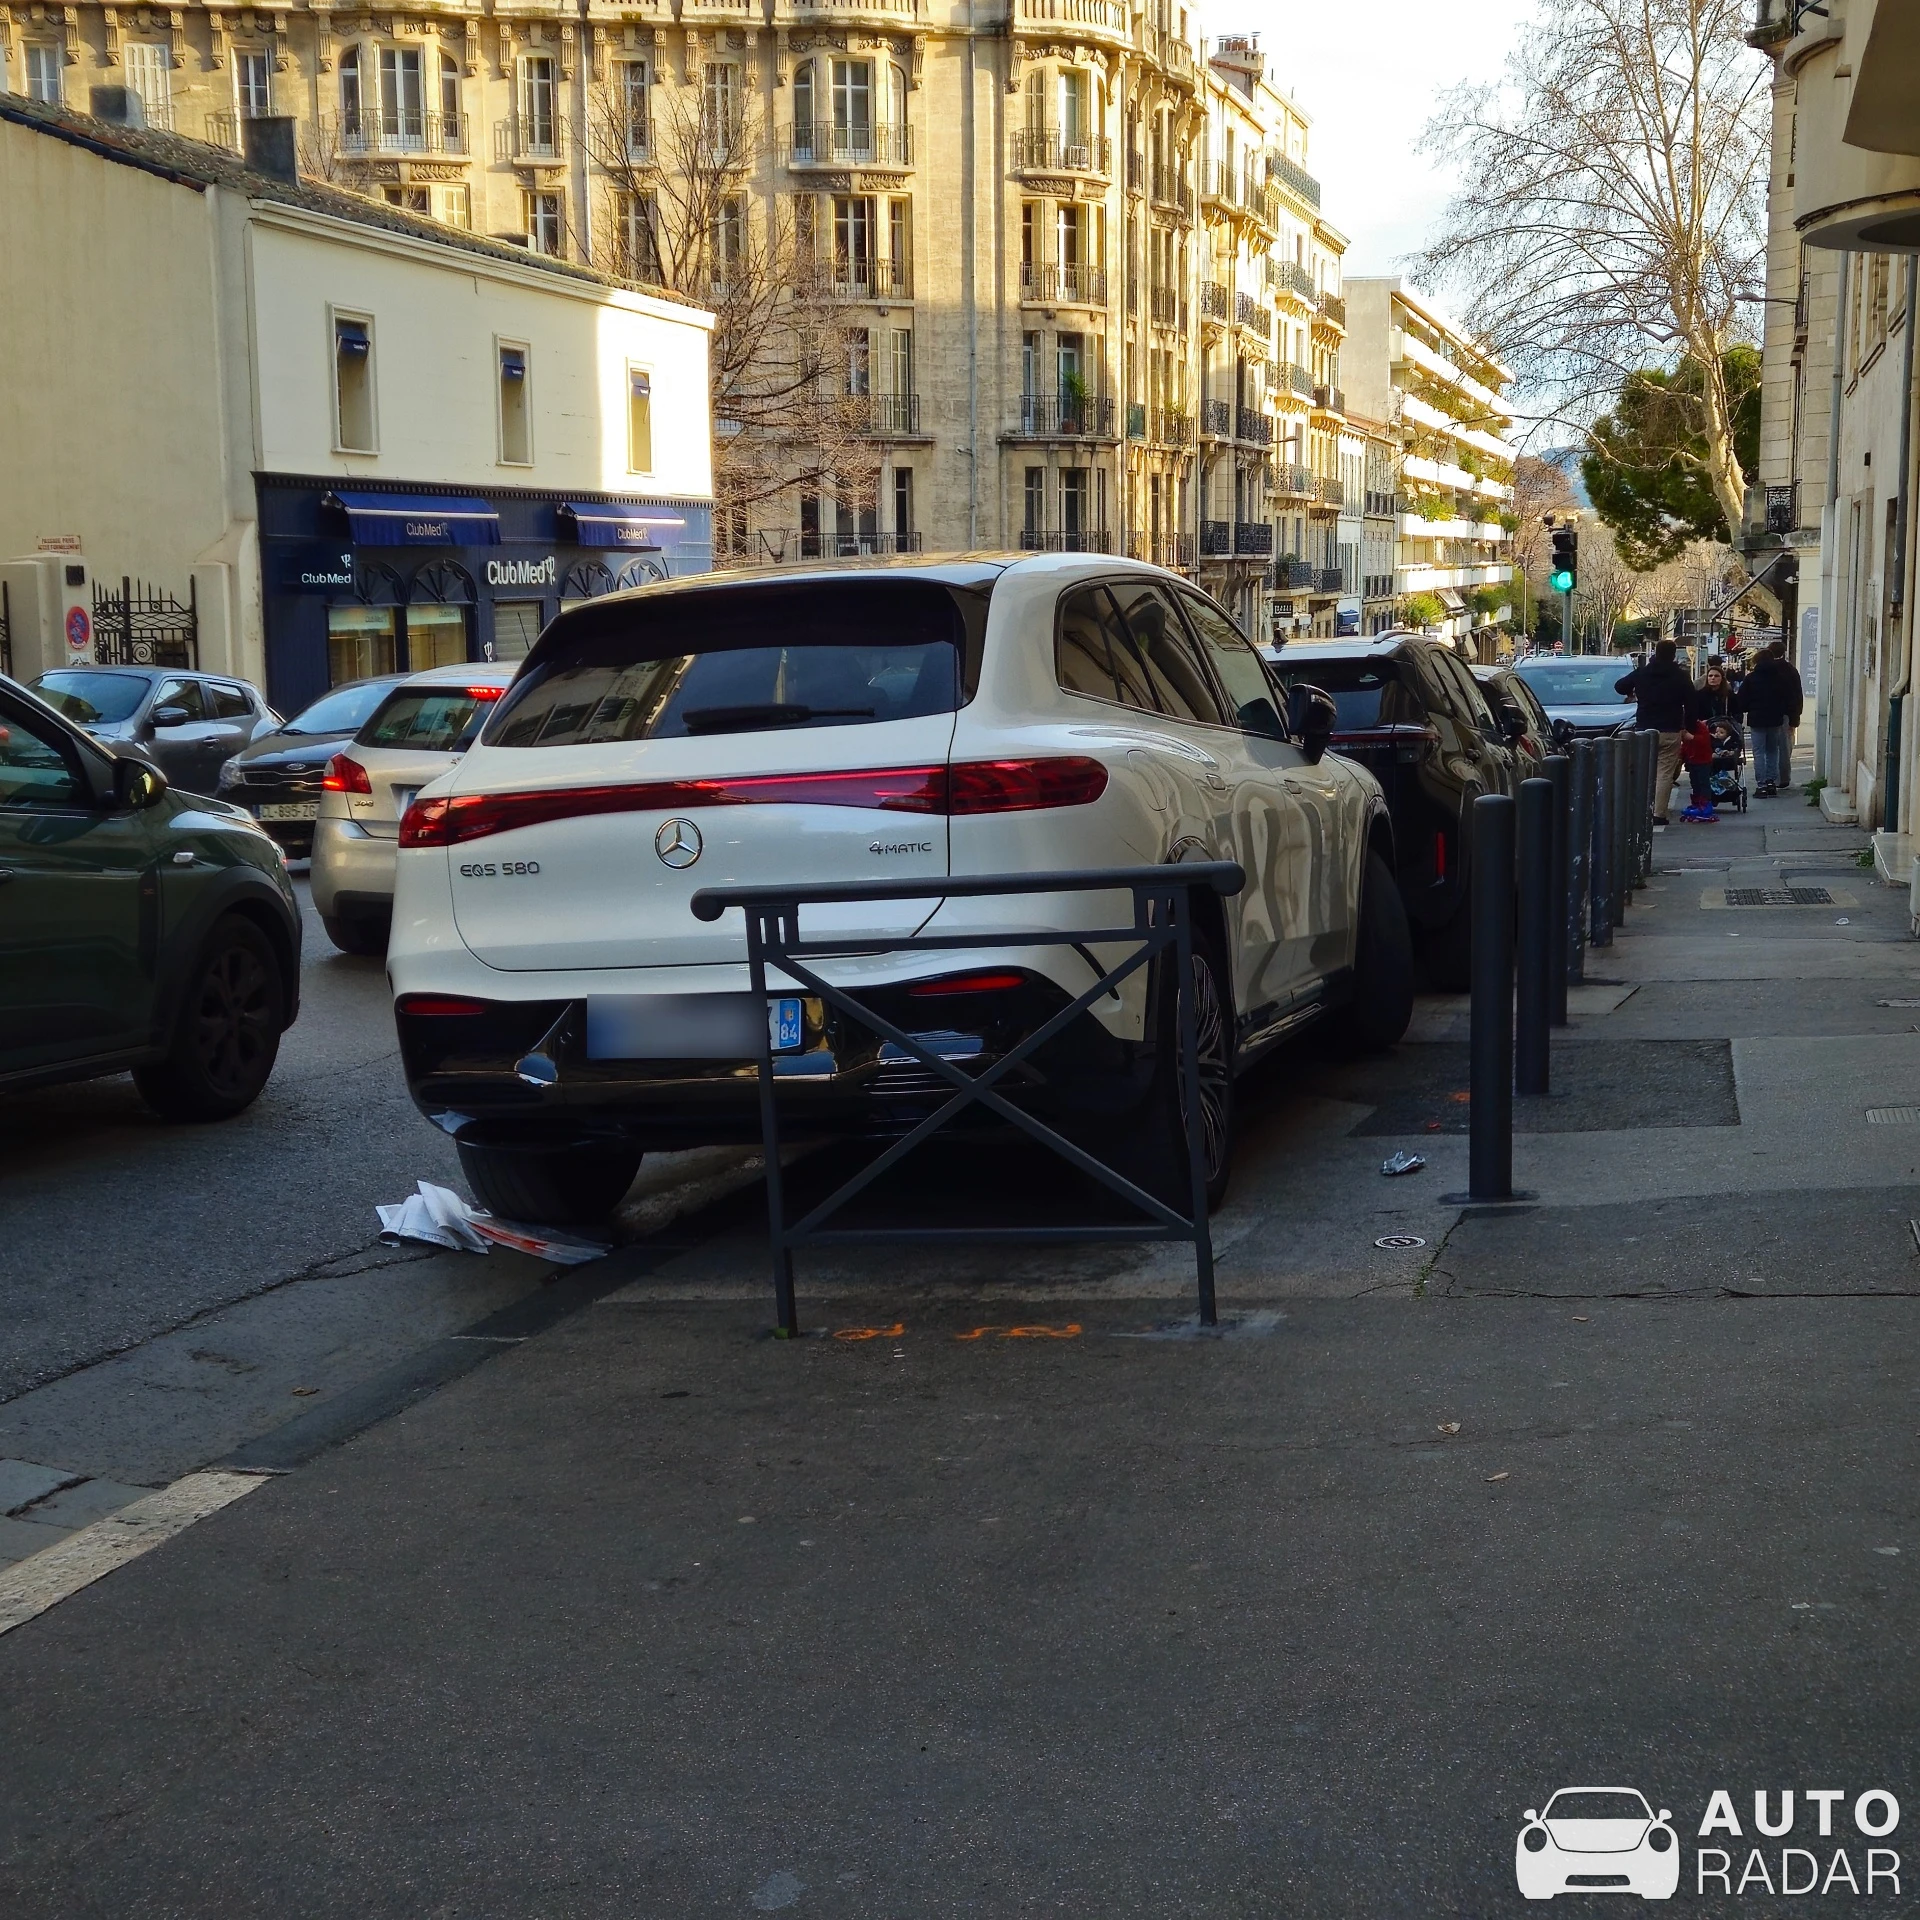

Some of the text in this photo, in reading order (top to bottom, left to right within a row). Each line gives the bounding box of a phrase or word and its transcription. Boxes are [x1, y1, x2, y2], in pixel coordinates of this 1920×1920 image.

[301, 573, 351, 584] Club Med
[486, 560, 545, 585] Club Med
[869, 840, 932, 854] 4MATIC
[460, 861, 540, 877] EQS 580
[781, 1023, 797, 1040] 84
